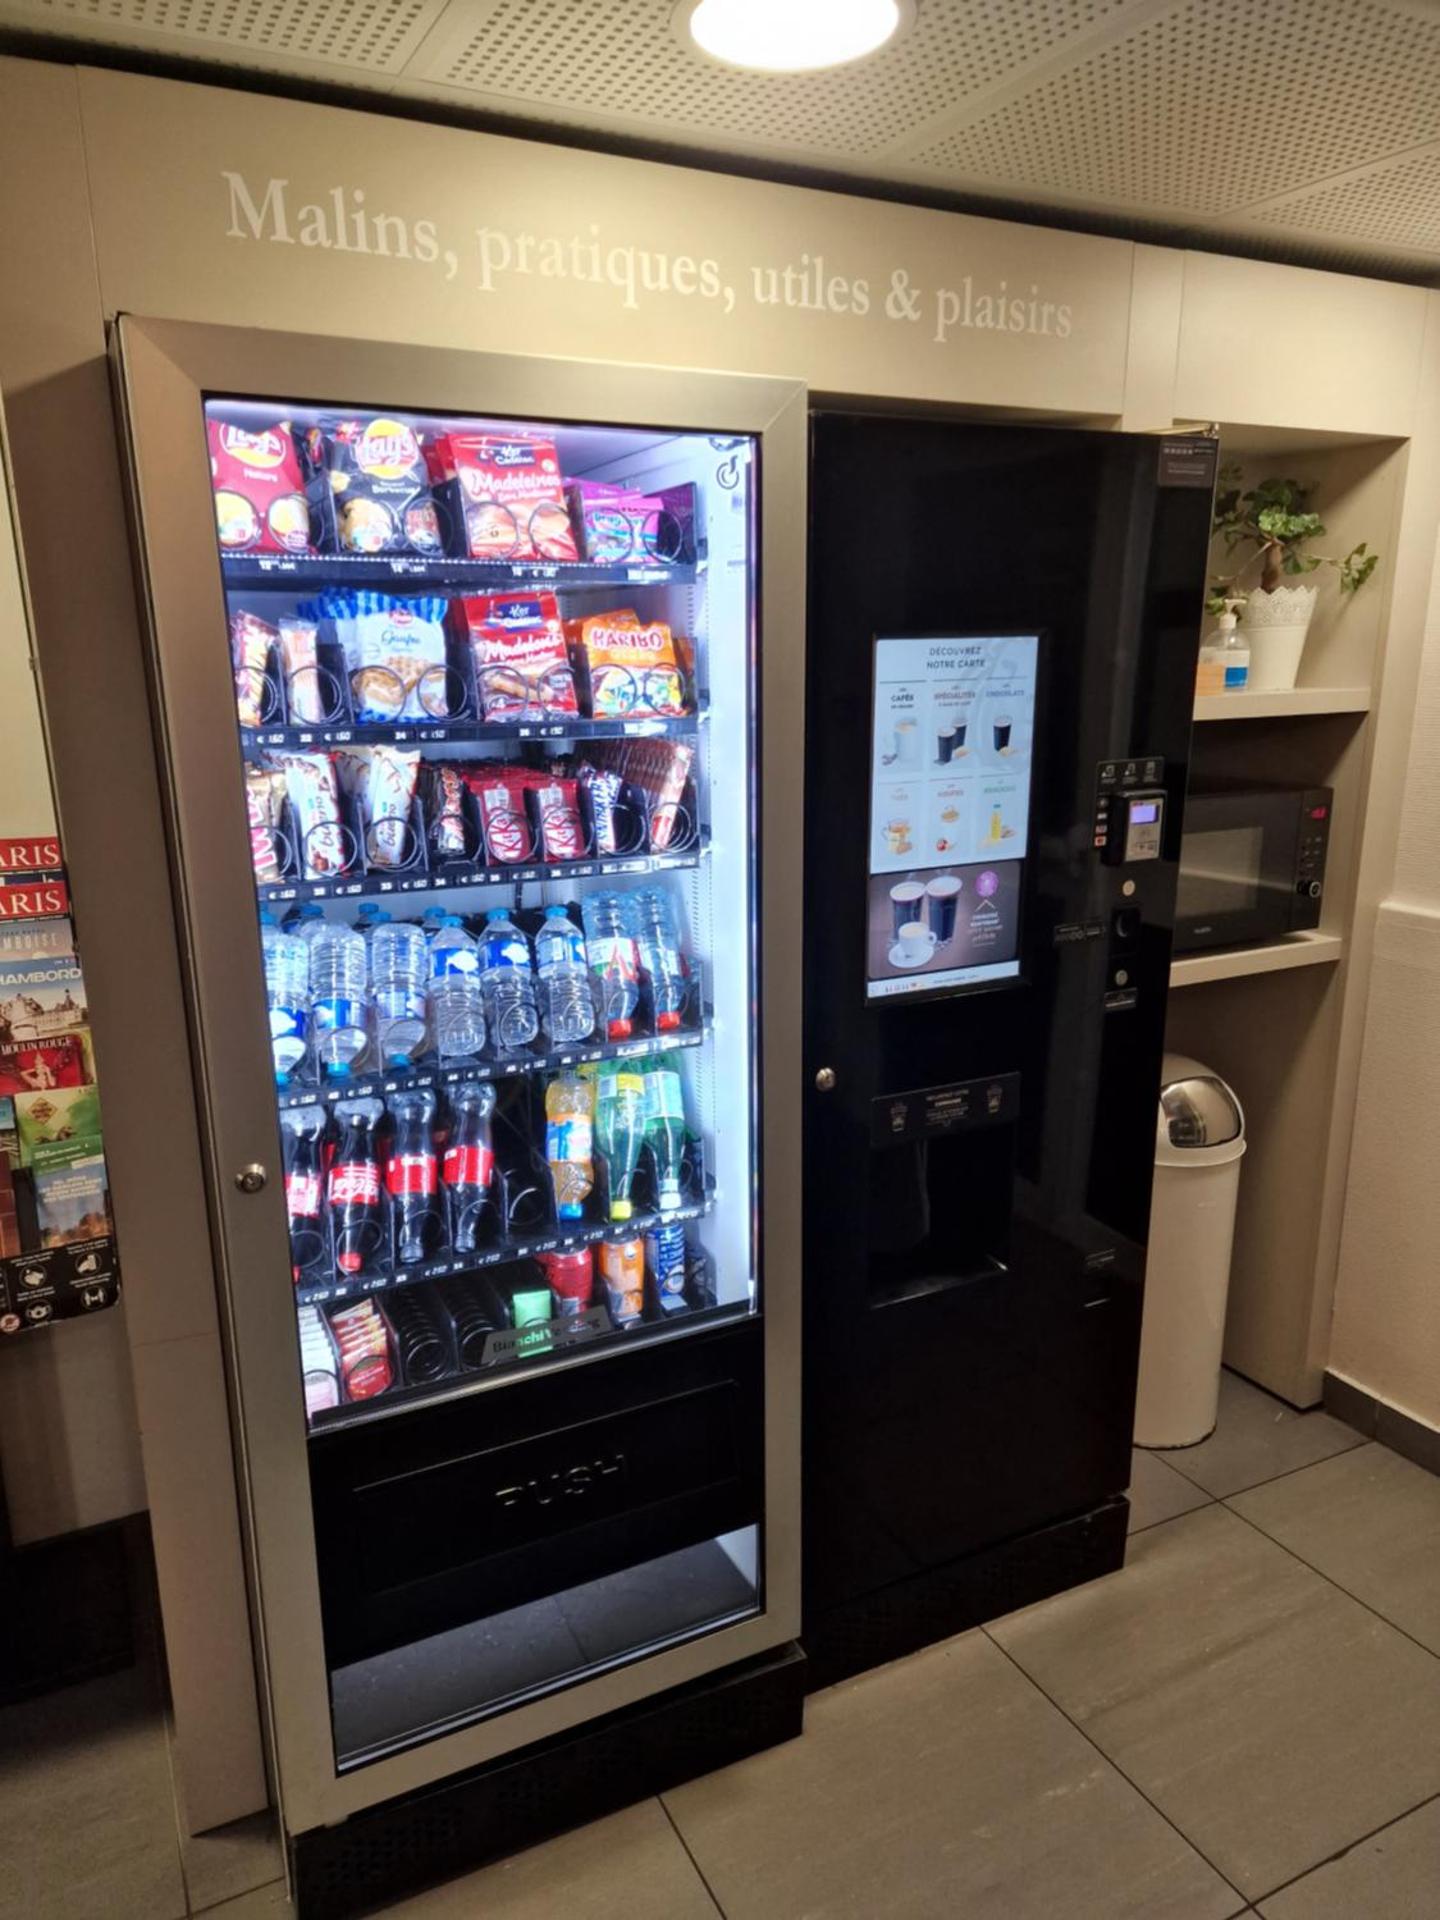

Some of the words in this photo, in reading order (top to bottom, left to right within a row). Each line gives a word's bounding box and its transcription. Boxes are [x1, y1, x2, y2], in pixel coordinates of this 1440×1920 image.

[222, 171, 458, 280] Malins,
[477, 224, 735, 313] pratiques,
[751, 254, 870, 316] utiles
[885, 269, 921, 321] &
[934, 277, 1072, 342] plaisirs
[592, 629, 663, 648] HARIBO
[929, 646, 982, 656] DÉCOUVREZ
[927, 660, 955, 669] NOTRE
[958, 659, 985, 668] CARTE
[496, 1455, 624, 1512] PUSH
